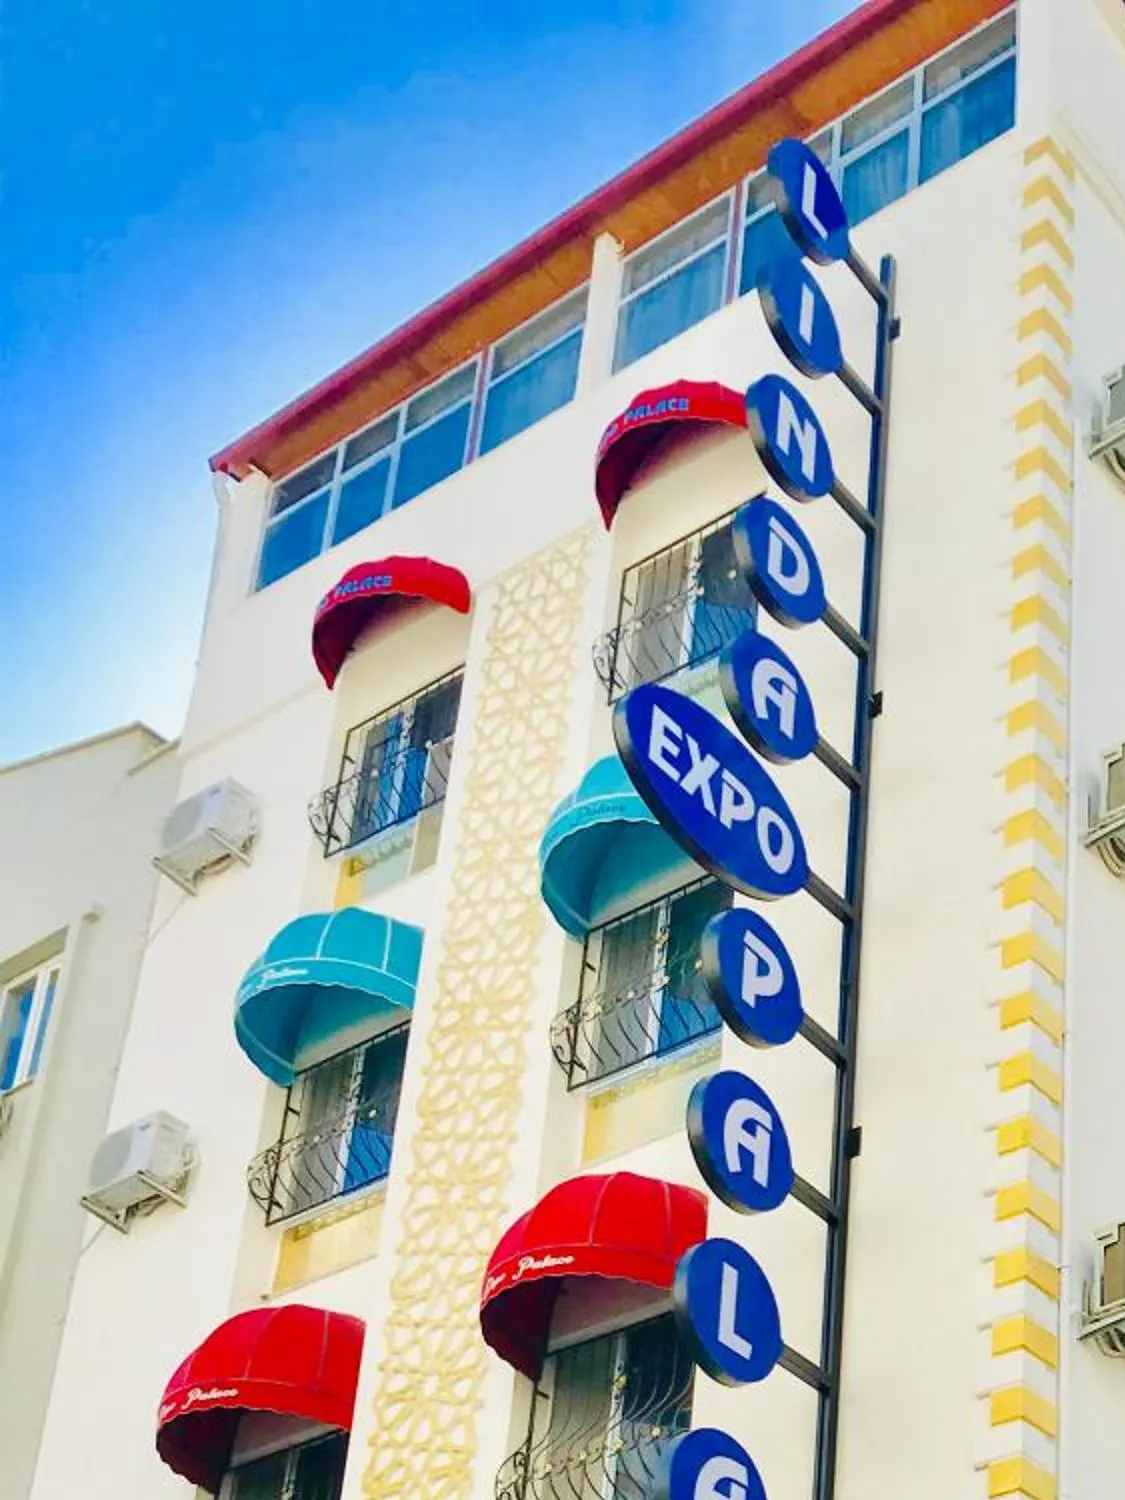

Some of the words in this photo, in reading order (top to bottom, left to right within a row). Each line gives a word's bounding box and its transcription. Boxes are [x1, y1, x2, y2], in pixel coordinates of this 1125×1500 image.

[623, 397, 689, 425] PALACE
[751, 163, 829, 740] LINDA
[648, 704, 795, 875] EXPO
[512, 1254, 576, 1280] Palace
